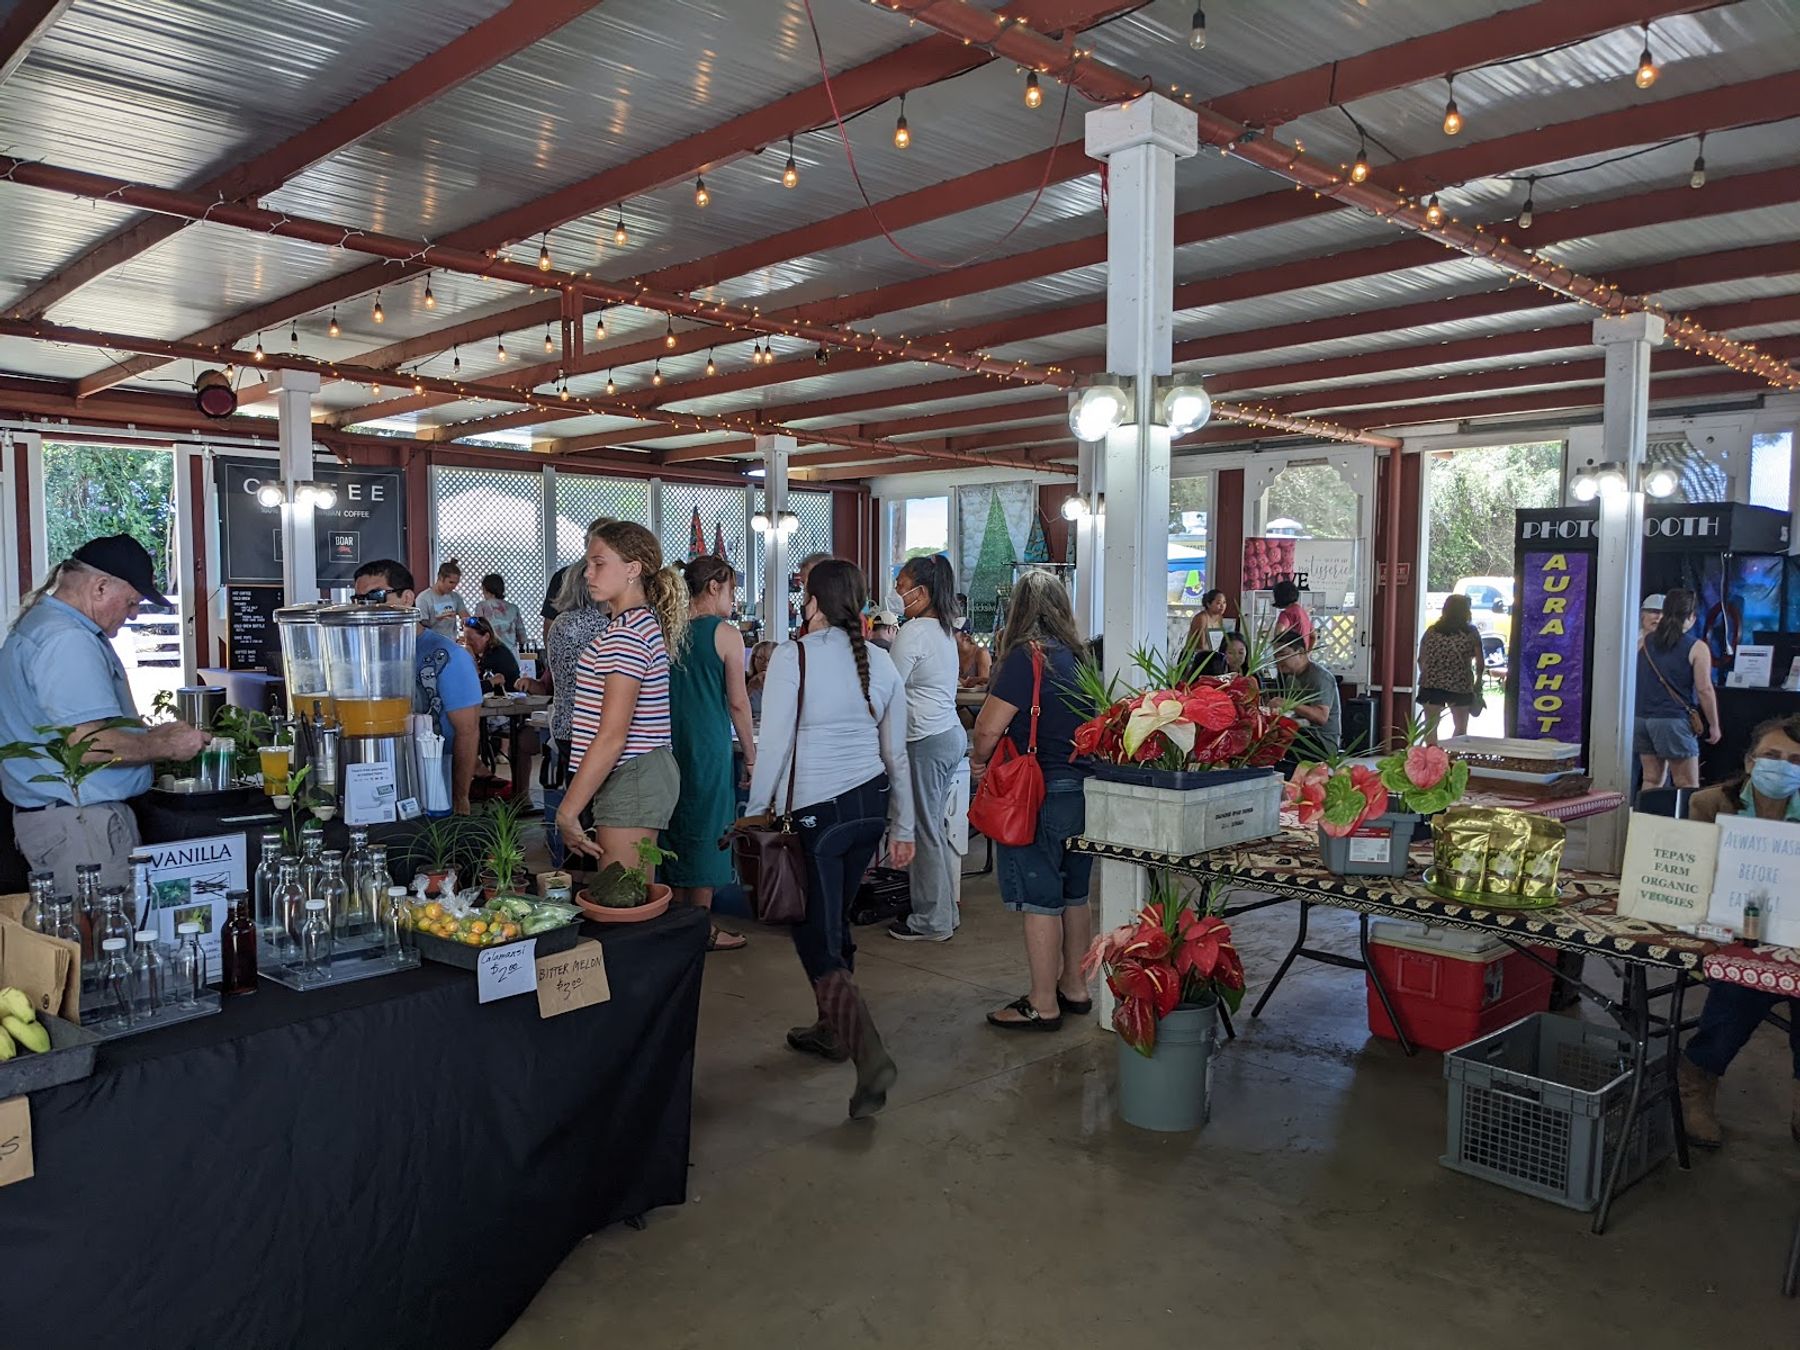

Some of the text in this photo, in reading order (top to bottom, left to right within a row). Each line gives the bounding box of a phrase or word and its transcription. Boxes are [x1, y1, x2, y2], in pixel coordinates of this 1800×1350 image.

[344, 510, 370, 518] COFFEE
[1643, 516, 1719, 537] OOTH
[335, 536, 353, 546] BOAR
[1538, 553, 1571, 636] AURA
[1533, 653, 1564, 742] PHOT
[1724, 831, 1768, 853] ALWAYS
[150, 843, 232, 869] VANILLA
[1654, 848, 1696, 863] TEPA'S
[1654, 862, 1690, 877] FARM
[1738, 863, 1780, 884] BEFORE
[1641, 875, 1699, 894] ORGANIC
[538, 956, 602, 981] BITTER MELON
